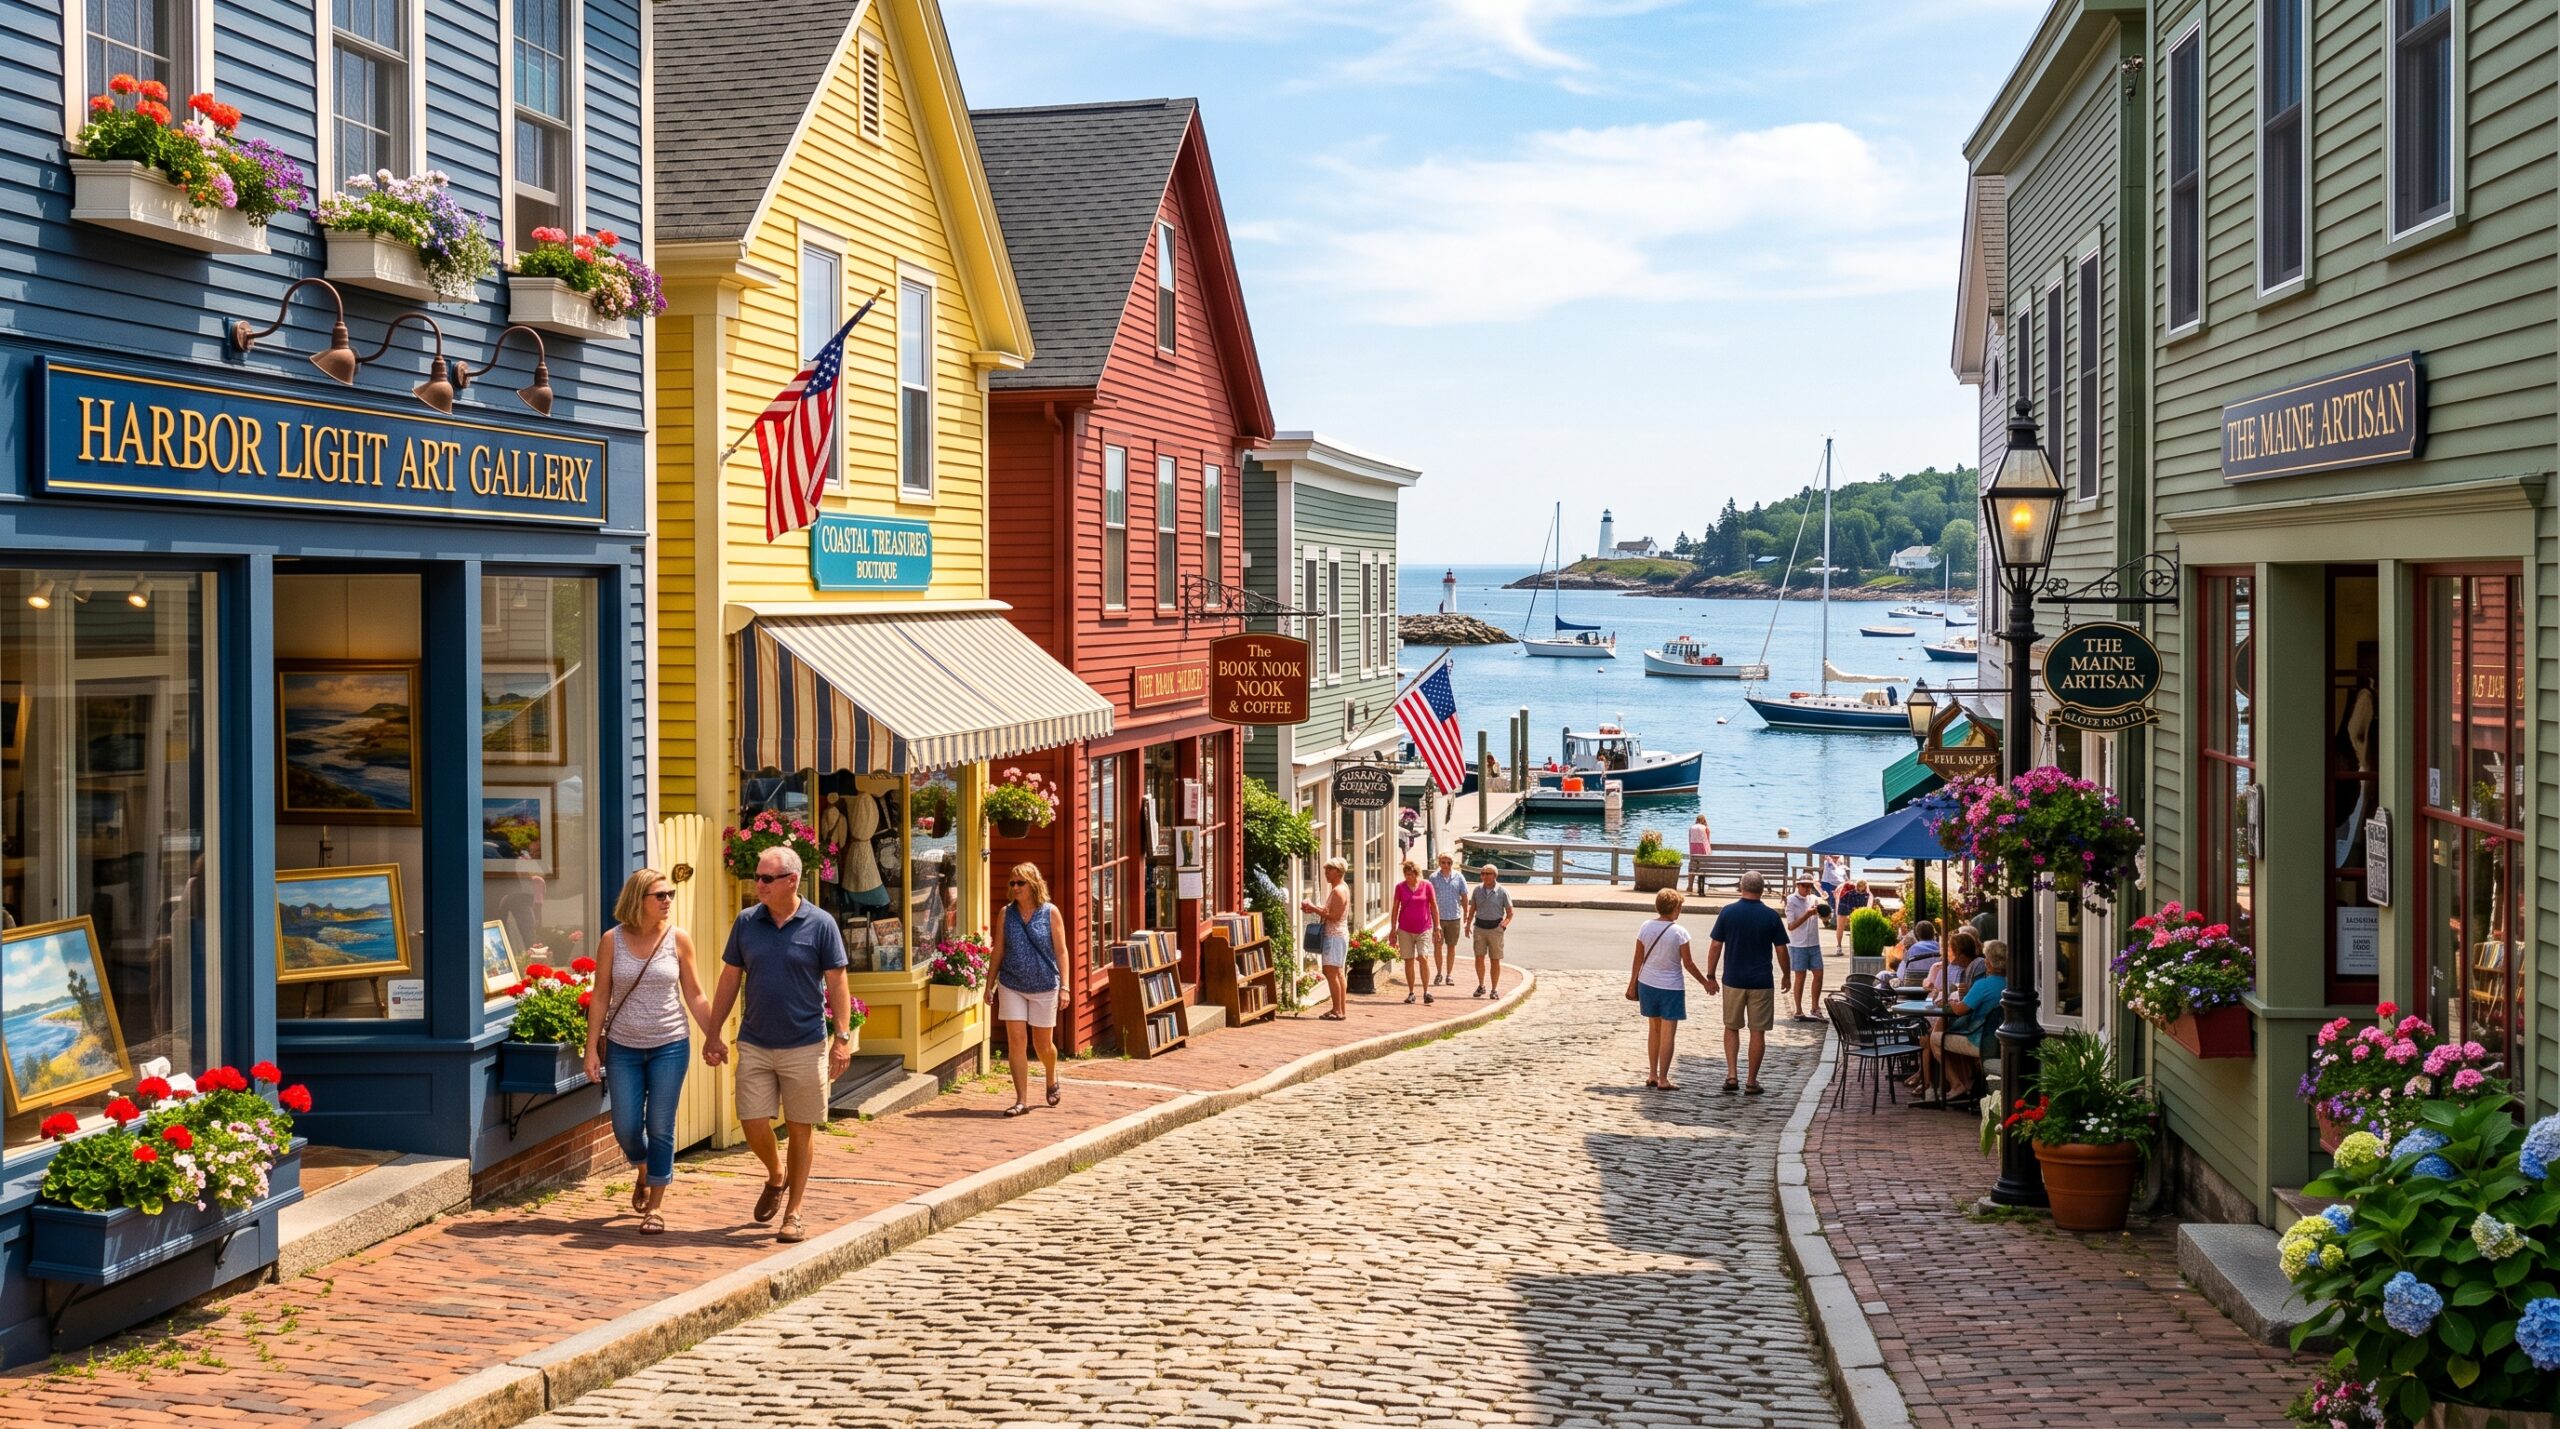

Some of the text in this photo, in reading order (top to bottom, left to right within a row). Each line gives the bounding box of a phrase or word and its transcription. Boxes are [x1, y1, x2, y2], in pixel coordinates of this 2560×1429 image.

[2227, 380, 2405, 463] THE MAINE ARTISAN
[77, 396, 593, 503] HARBOR LIGHT ART GALLERY
[821, 524, 928, 557] COASTAL TREASURES
[856, 560, 897, 583] BOUTIQUE
[1247, 644, 1271, 658] The
[2083, 638, 2122, 653] THE
[1218, 661, 1301, 677] BOOK NOOK
[2070, 656, 2136, 671] MAINE
[1236, 680, 1285, 697] NOOK
[2060, 674, 2146, 689] ARTISAN
[1229, 700, 1292, 715] & COFFEE
